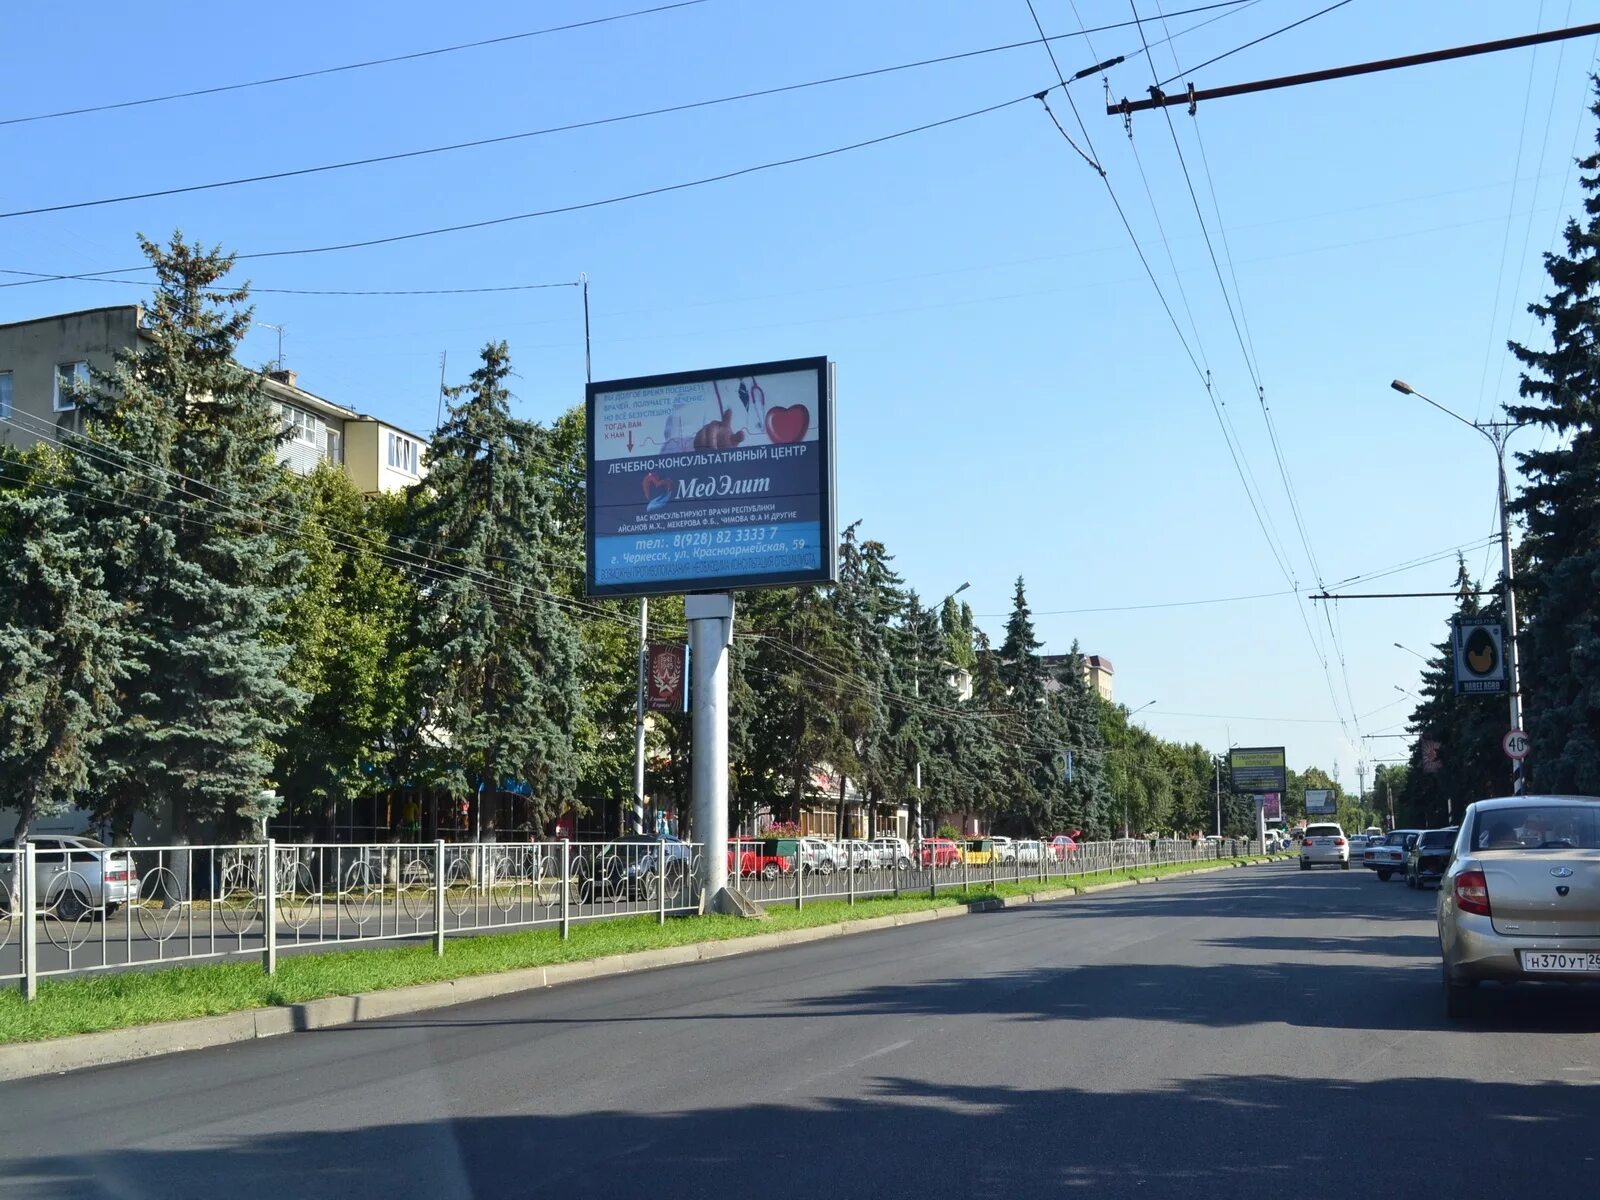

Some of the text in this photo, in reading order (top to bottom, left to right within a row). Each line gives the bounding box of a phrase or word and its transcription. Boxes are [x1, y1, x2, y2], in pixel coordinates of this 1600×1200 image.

[665, 384, 705, 394] ПОСЕЩАЕТЕ
[633, 398, 671, 408] ПОЛУЧАЕТЕ
[604, 420, 642, 431] ТОГДА ВАМ
[608, 445, 807, 474] ЛЕЧЕБНО-КОНСУЛЬТАТИВНЫЙ ЦЕНТР
[618, 523, 648, 533] АЙСАНОВ
[667, 519, 701, 528] МЕКЕРОВА
[721, 515, 749, 524] ЧИМОВА
[771, 511, 798, 521] ДРУГИЕ
[636, 504, 776, 522] ВАС КОНСУЛЬТИРУЮТ ВРАЧИ РЕСПУБЛИКИ
[673, 533, 713, 548] 8(928)
[716, 531, 731, 542] 82
[735, 528, 765, 542] 3333
[769, 526, 778, 540] 7
[623, 551, 671, 564] Черкесск,
[674, 550, 689, 562] ул.
[693, 542, 789, 560] Красноармейская,
[792, 538, 805, 550] 59
[1508, 738, 1524, 752] 40
